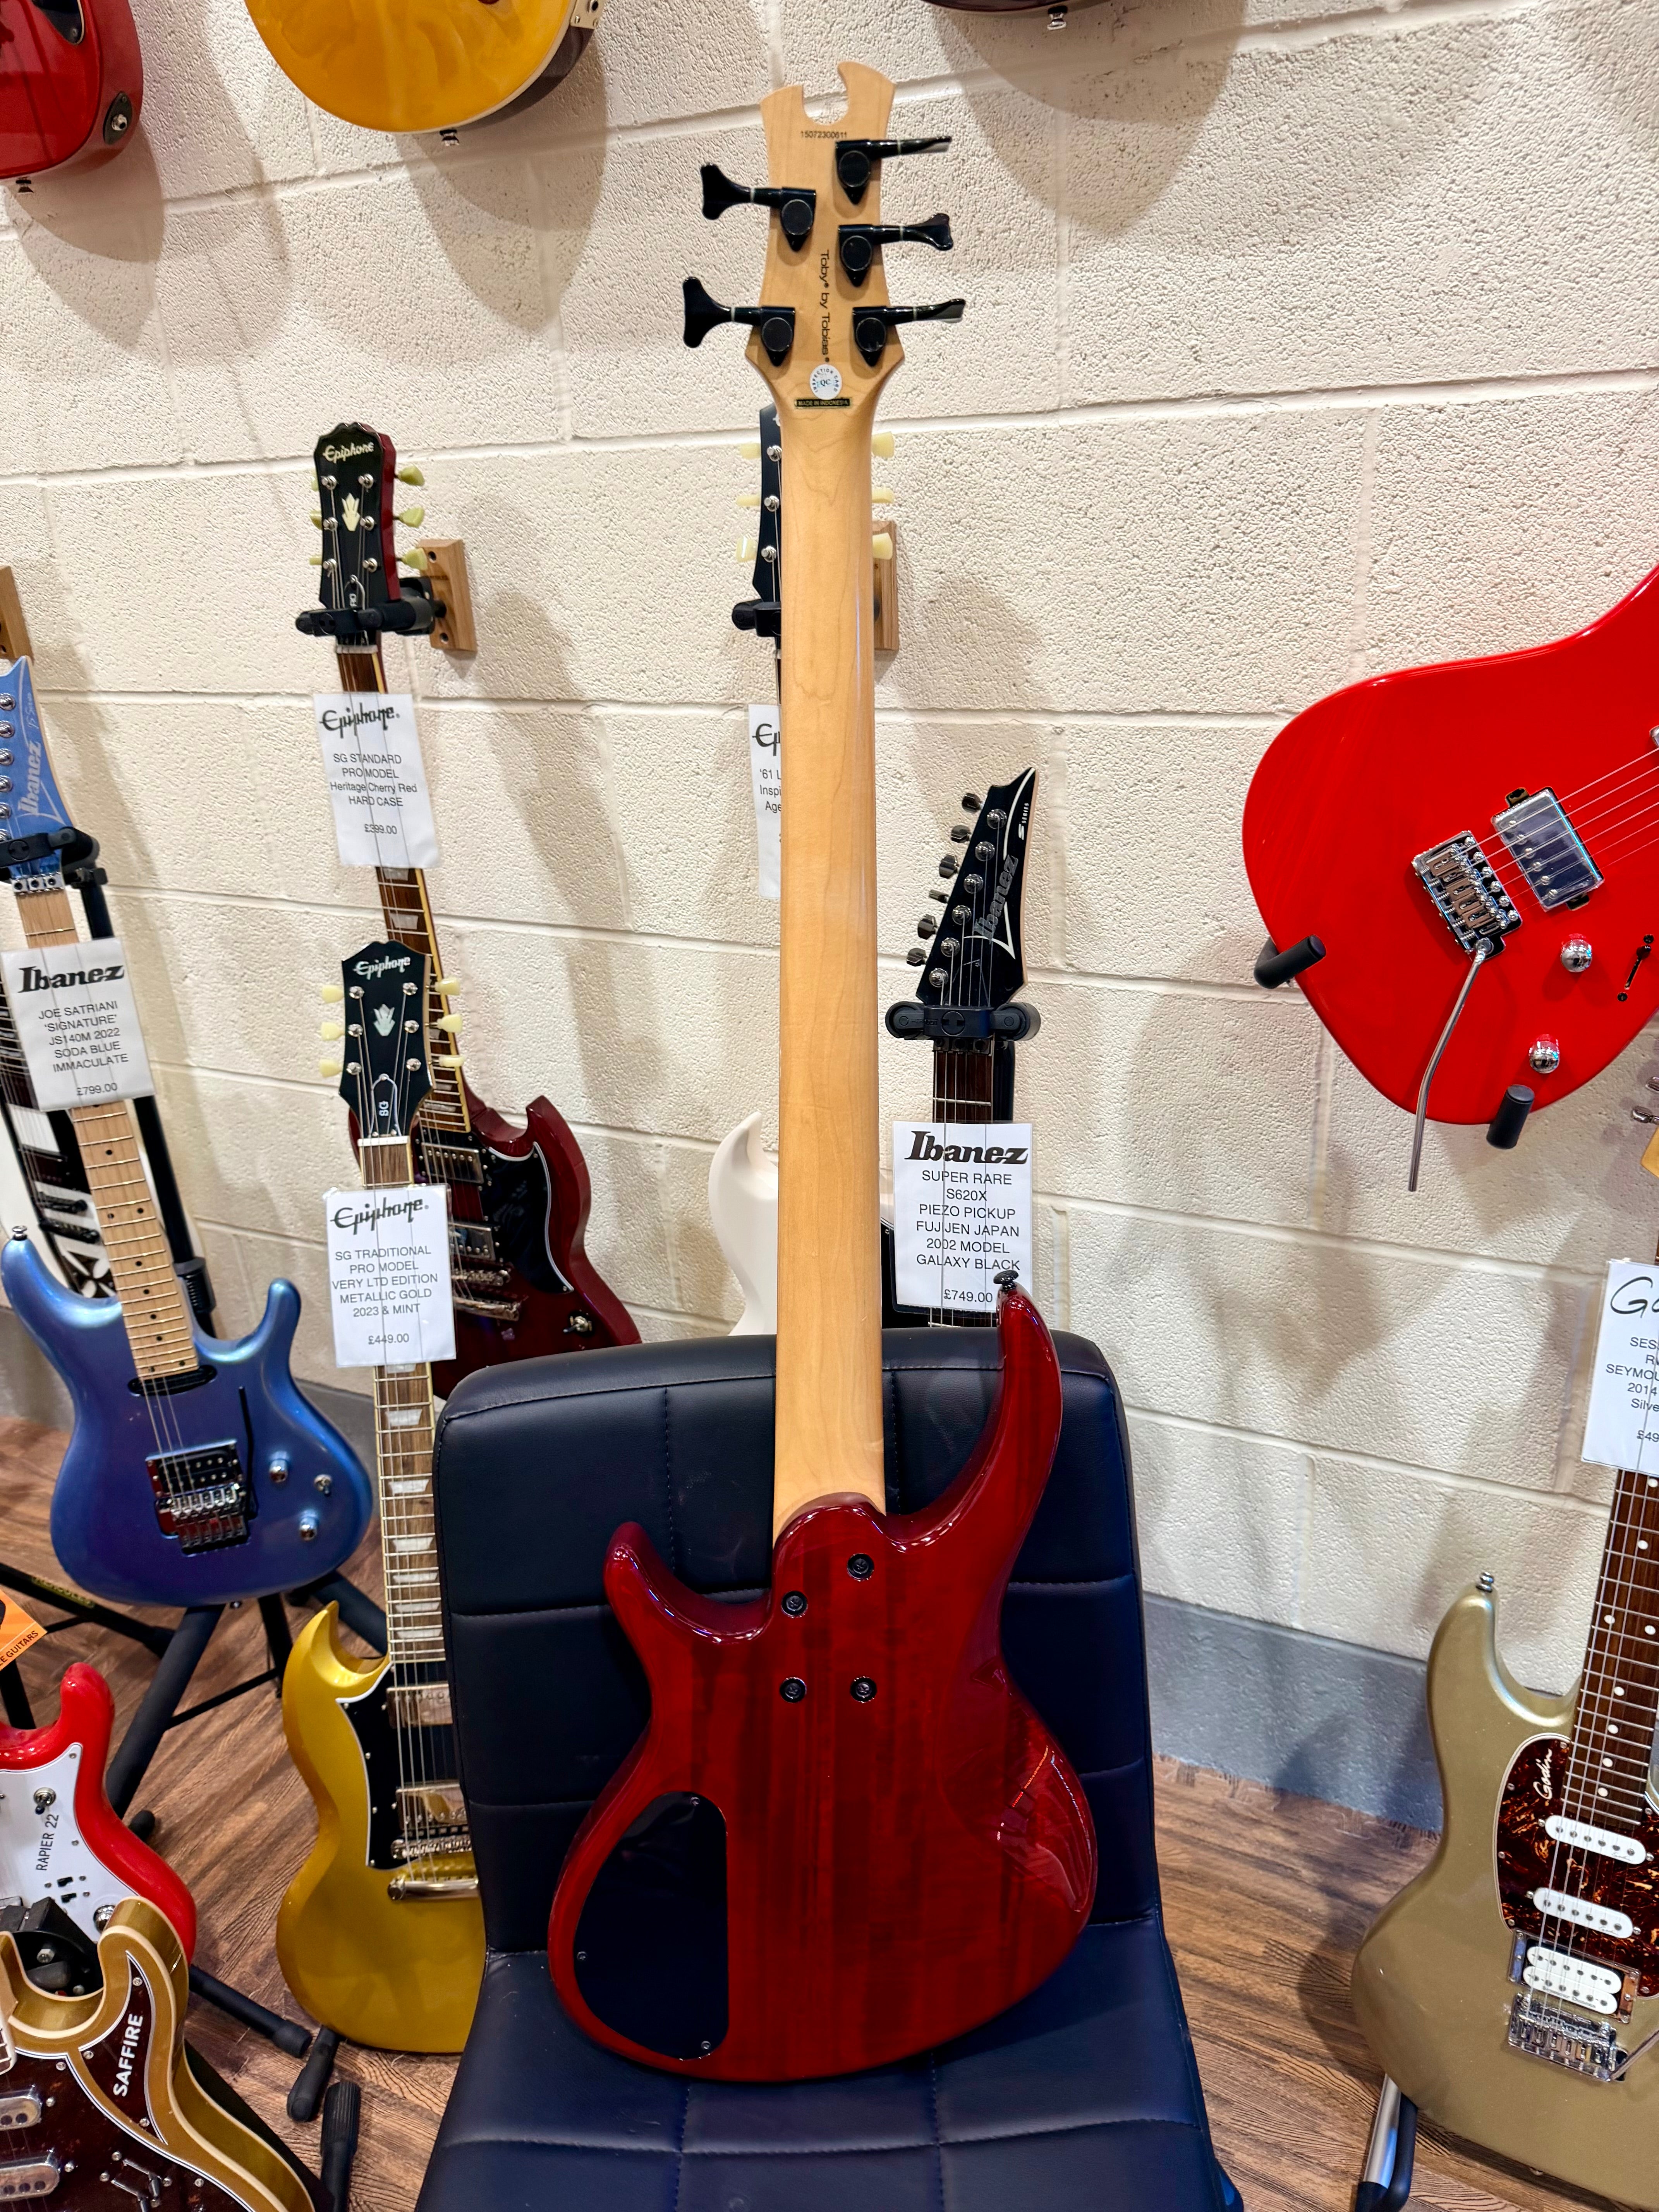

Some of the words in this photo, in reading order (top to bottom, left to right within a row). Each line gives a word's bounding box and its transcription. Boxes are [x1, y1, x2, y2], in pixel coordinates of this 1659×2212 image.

[800, 130, 847, 139] 15072300611
[820, 292, 830, 309] by
[323, 441, 375, 464] Epiphone
[333, 754, 347, 763] SG
[350, 753, 402, 764] STANDARD
[18, 740, 41, 815] Ibanez
[342, 768, 363, 778] PRO
[366, 769, 399, 779] MODEL
[330, 782, 366, 793] Heritage
[369, 783, 395, 794] Cherry
[398, 783, 417, 793] Red
[349, 796, 375, 806] HARD
[377, 797, 404, 807] CASE
[1021, 803, 1029, 824] SERIES
[364, 824, 398, 835] £399.00
[974, 854, 1019, 945] Ibanez
[353, 955, 410, 980] Epiphone
[17, 965, 124, 993] Ibanez
[39, 1008, 61, 1020] JOE
[64, 1000, 118, 1017] SATRIANI
[49, 1034, 91, 1046] JS140M
[94, 1028, 120, 1039] 2022
[54, 1047, 88, 1059] SODA
[91, 1041, 121, 1053] BLUE
[53, 1053, 129, 1072] IMMACULATE
[76, 1082, 118, 1096] £799.00
[379, 1100, 389, 1117] SG
[904, 1130, 1029, 1165] Ibanez
[922, 1170, 969, 1184] SUPER
[973, 1173, 1012, 1185] RARE
[946, 1188, 988, 1201] S620X
[919, 1204, 960, 1217] PIEZO
[964, 1207, 1016, 1219] PICKUP
[974, 1225, 1020, 1237] JAPAN
[335, 1250, 352, 1261] SG
[355, 1245, 432, 1259] TRADITIONAL
[926, 1238, 957, 1250] 2002
[960, 1242, 1010, 1254] MODEL
[350, 1263, 375, 1274] PRO
[379, 1261, 419, 1272] MODEL
[916, 1254, 970, 1269] GALAXY
[975, 1257, 1020, 1271] BLACK
[332, 1278, 363, 1290] VERY
[367, 1277, 388, 1287] LTD
[392, 1274, 438, 1286] EDITION
[340, 1291, 396, 1304] METALLIC
[399, 1288, 432, 1299] GOLD
[944, 1289, 993, 1303] £749.00
[353, 1307, 380, 1317] 2023
[382, 1305, 390, 1315] &
[393, 1303, 421, 1314] MINT
[368, 1333, 410, 1345] £449.00
[1630, 1337, 1659, 1350] SES
[1627, 1382, 1657, 1396] 2014
[6, 1630, 39, 1658] GUITARS
[1532, 1748, 1553, 1800] Godin
[35, 1832, 54, 1871] RAPIER
[45, 1814, 59, 1829] 22
[113, 2013, 143, 2097] SAFFIRE
